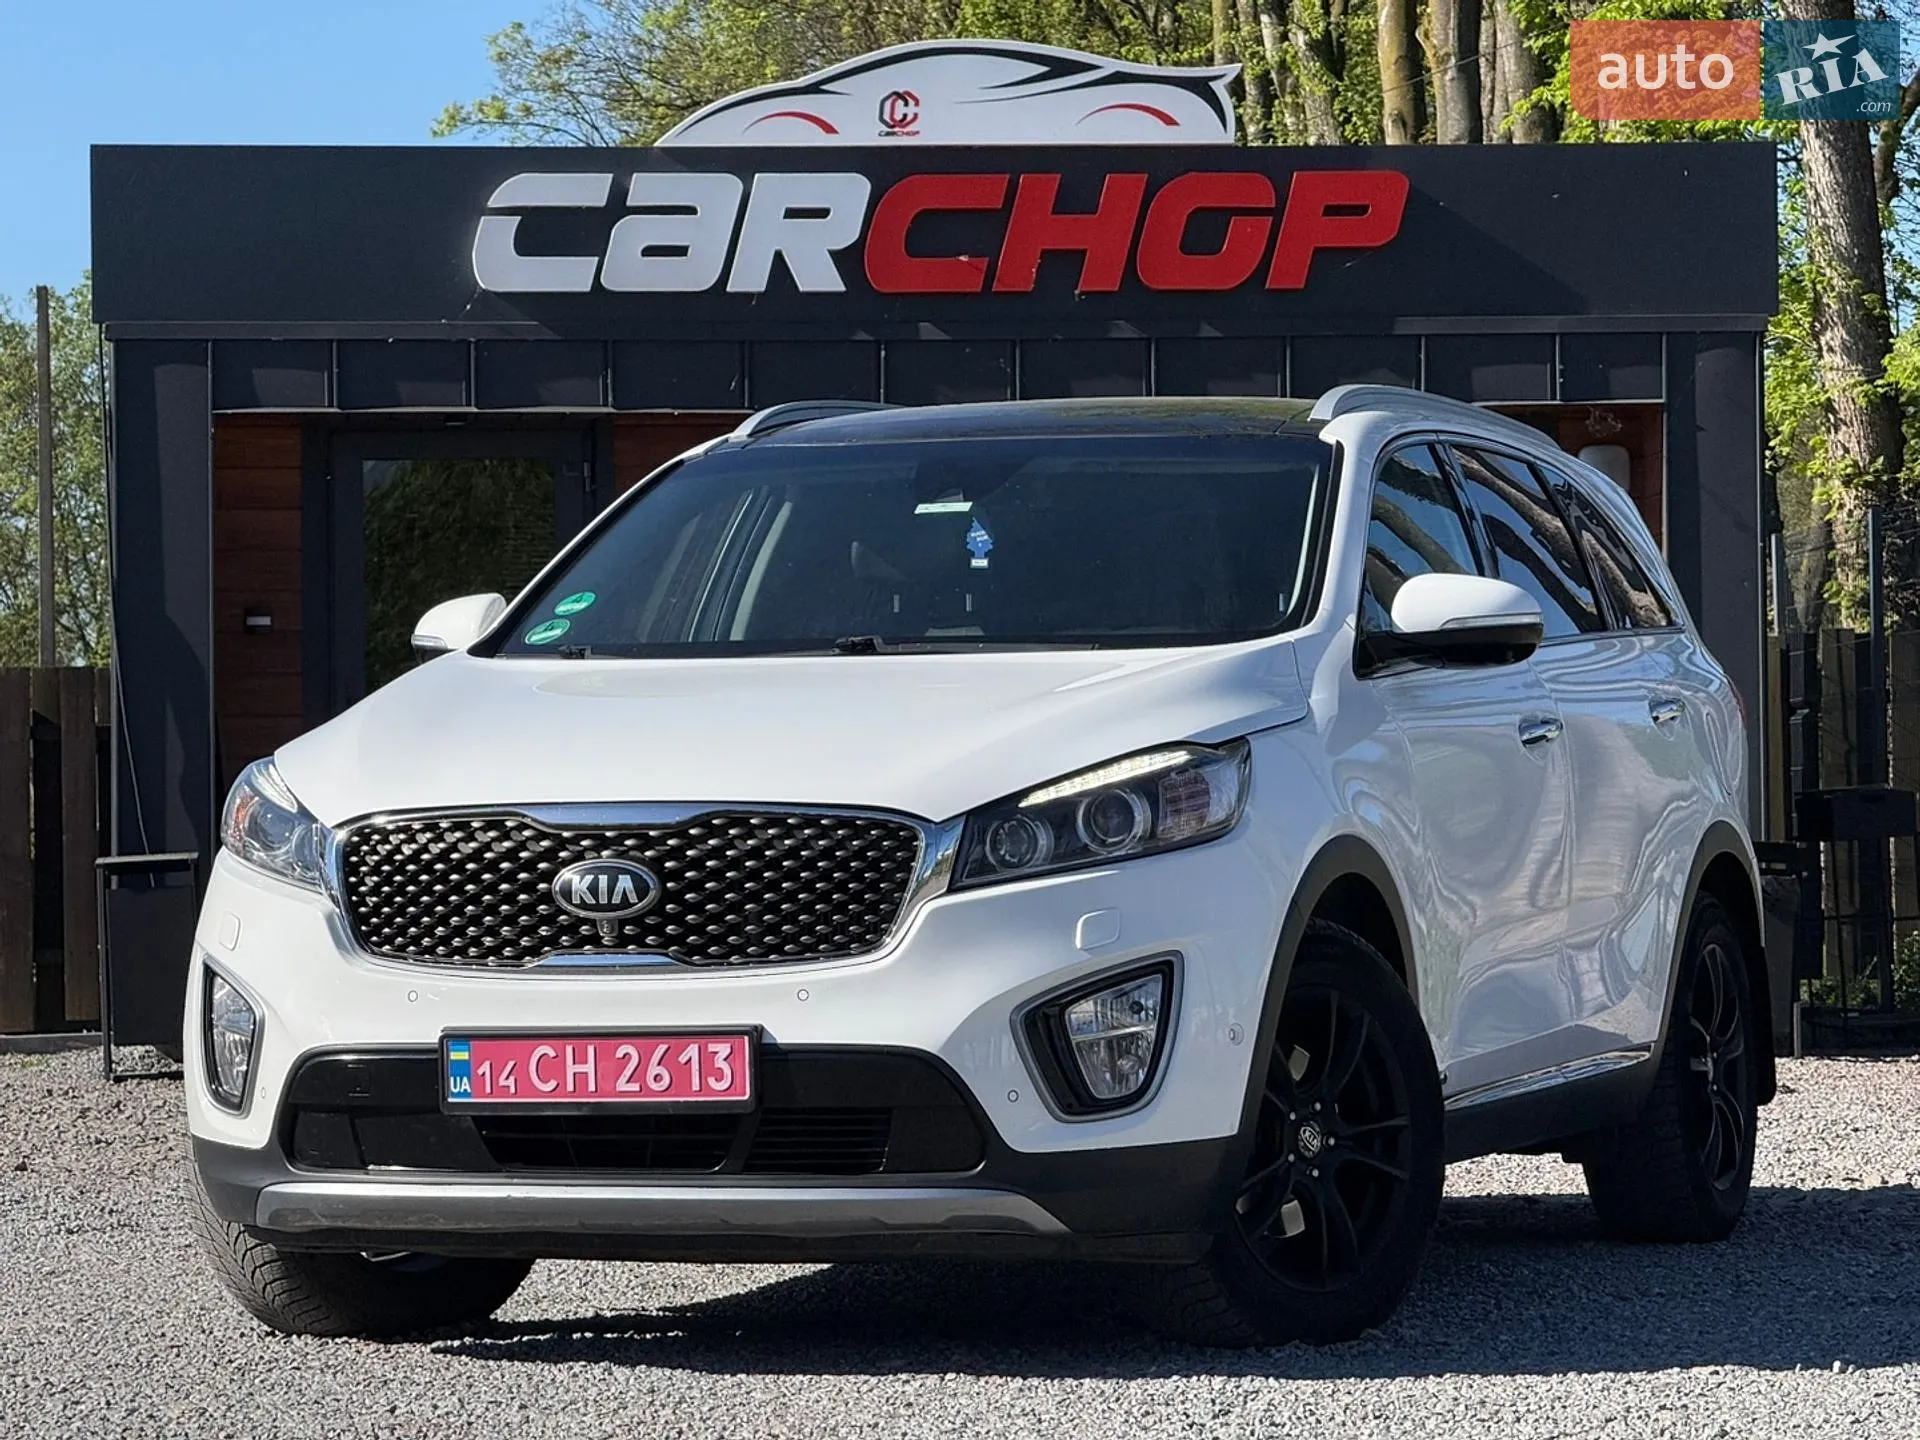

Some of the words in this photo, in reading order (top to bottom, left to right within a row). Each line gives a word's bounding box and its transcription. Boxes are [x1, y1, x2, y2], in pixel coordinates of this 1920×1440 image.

[571, 874, 639, 905] KIA
[477, 1059, 518, 1095] 14
[528, 1044, 599, 1093] CH
[615, 1043, 734, 1092] 2613
[450, 1077, 471, 1094] UA
